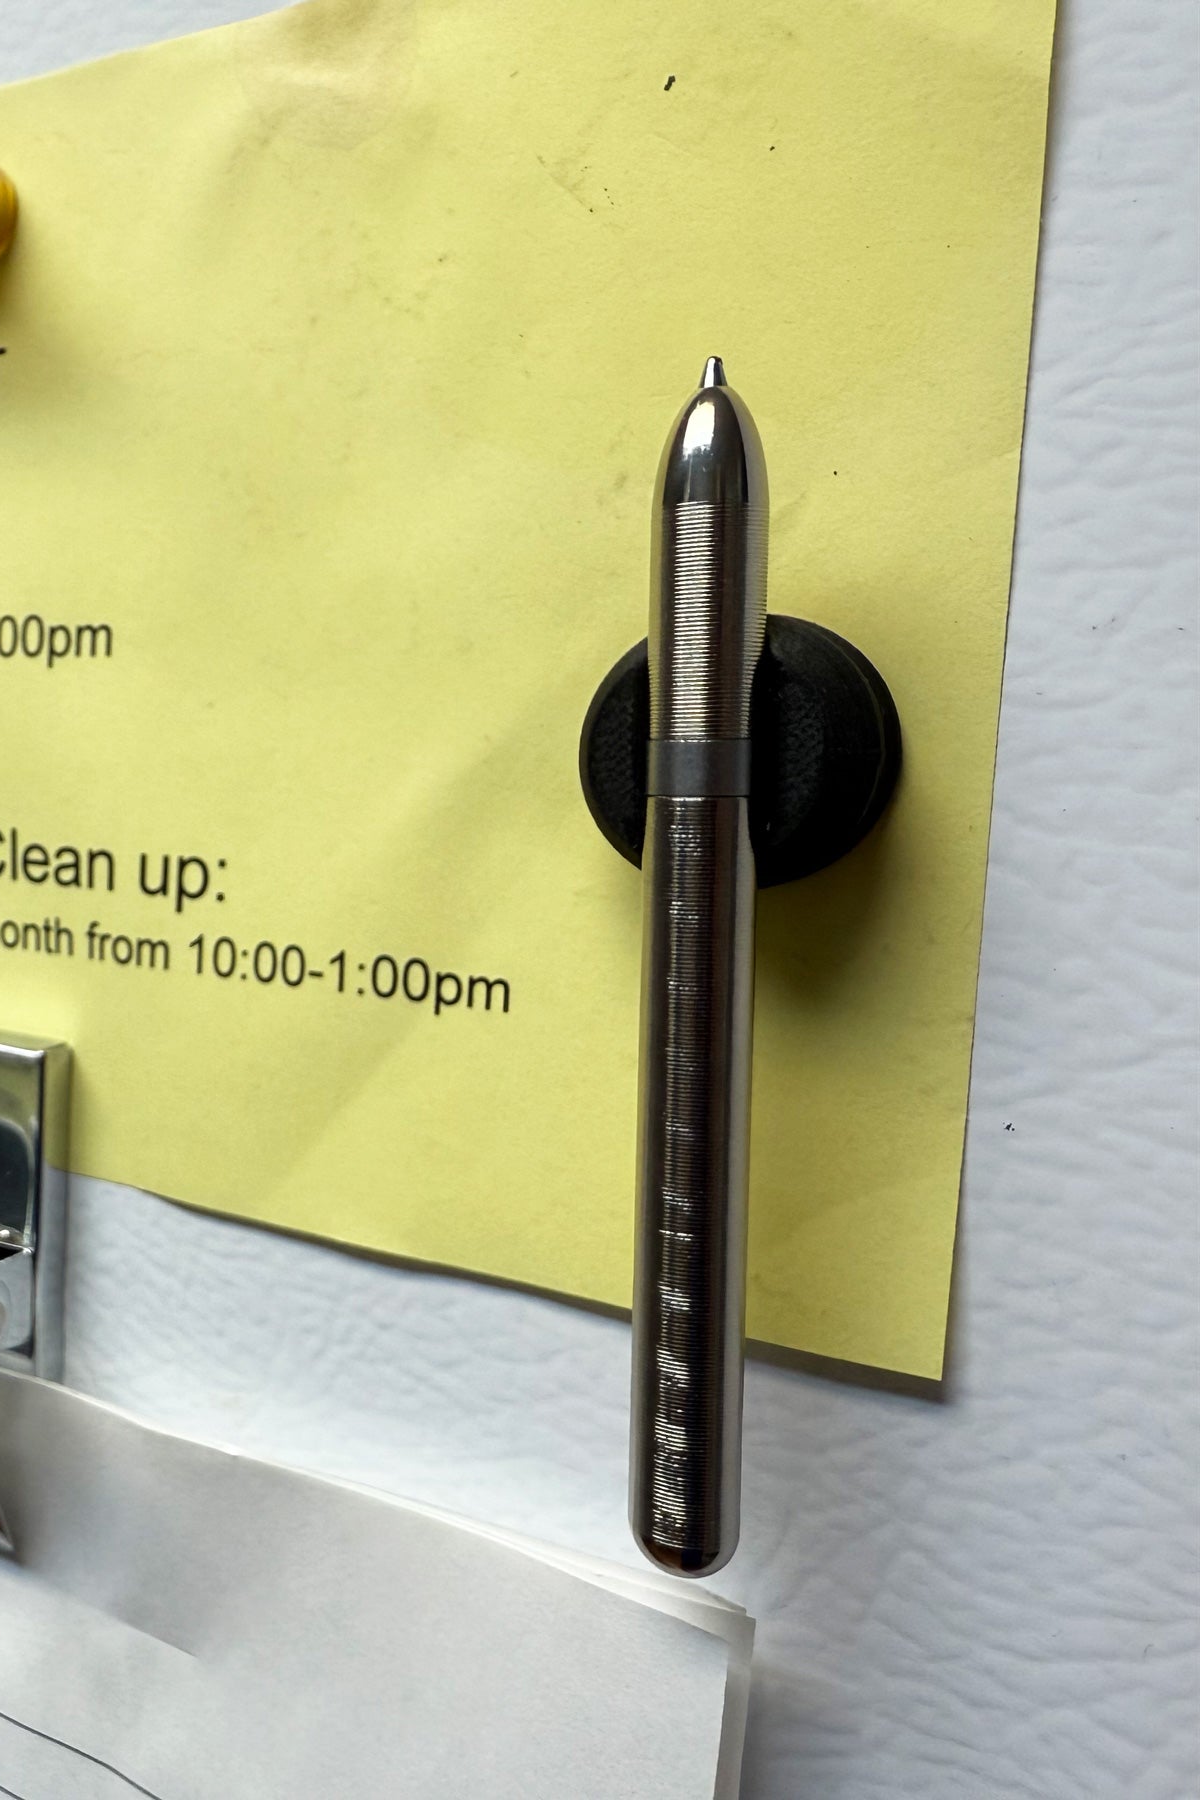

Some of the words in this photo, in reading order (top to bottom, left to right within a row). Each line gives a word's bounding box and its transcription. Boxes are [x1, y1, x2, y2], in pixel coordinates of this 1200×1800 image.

[138, 852, 228, 915] up:
[85, 919, 171, 972] from
[188, 933, 512, 1017] 10:00-1:00pm
